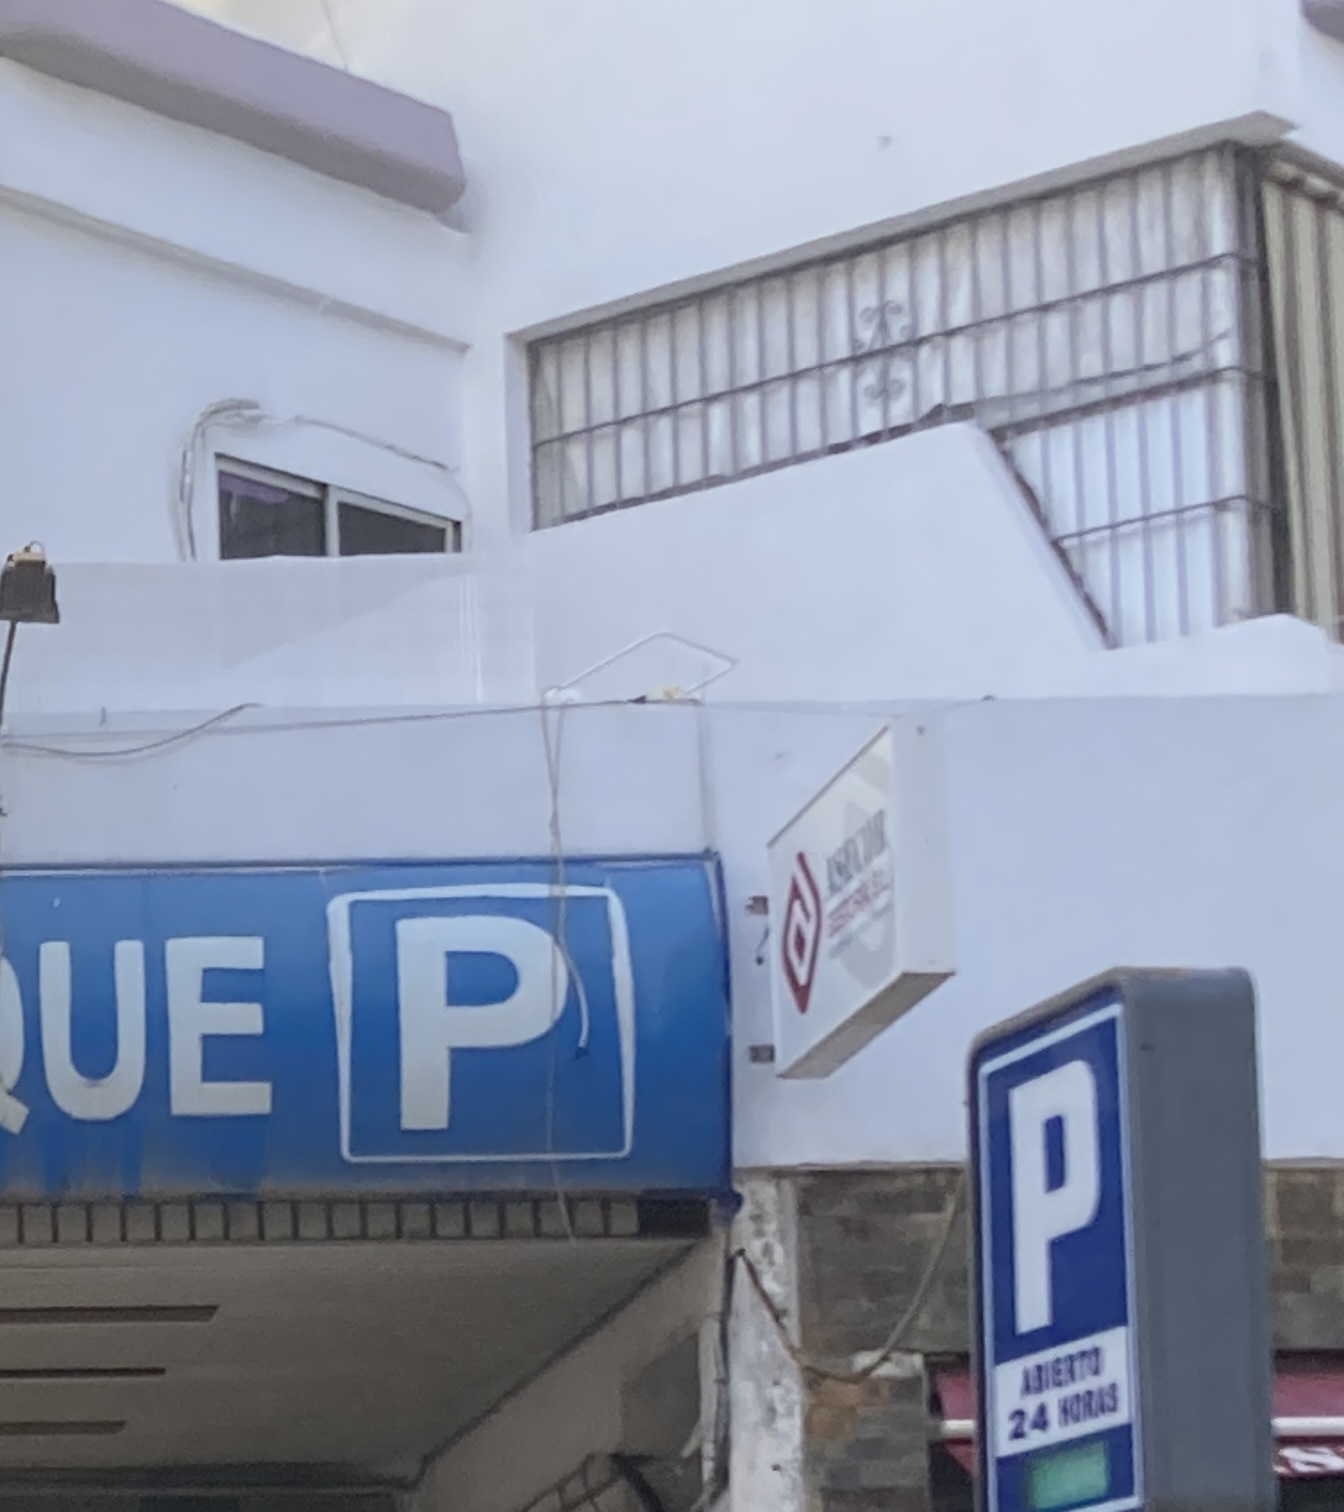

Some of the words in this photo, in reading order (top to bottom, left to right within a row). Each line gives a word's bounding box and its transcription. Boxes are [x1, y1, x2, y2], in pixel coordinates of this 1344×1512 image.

[396, 914, 571, 1131] P
[1008, 1059, 1102, 1337] P
[1008, 1402, 1049, 1441] 24
[1057, 1382, 1118, 1428] HORAS
[1020, 1346, 1101, 1398] ABIERTO
